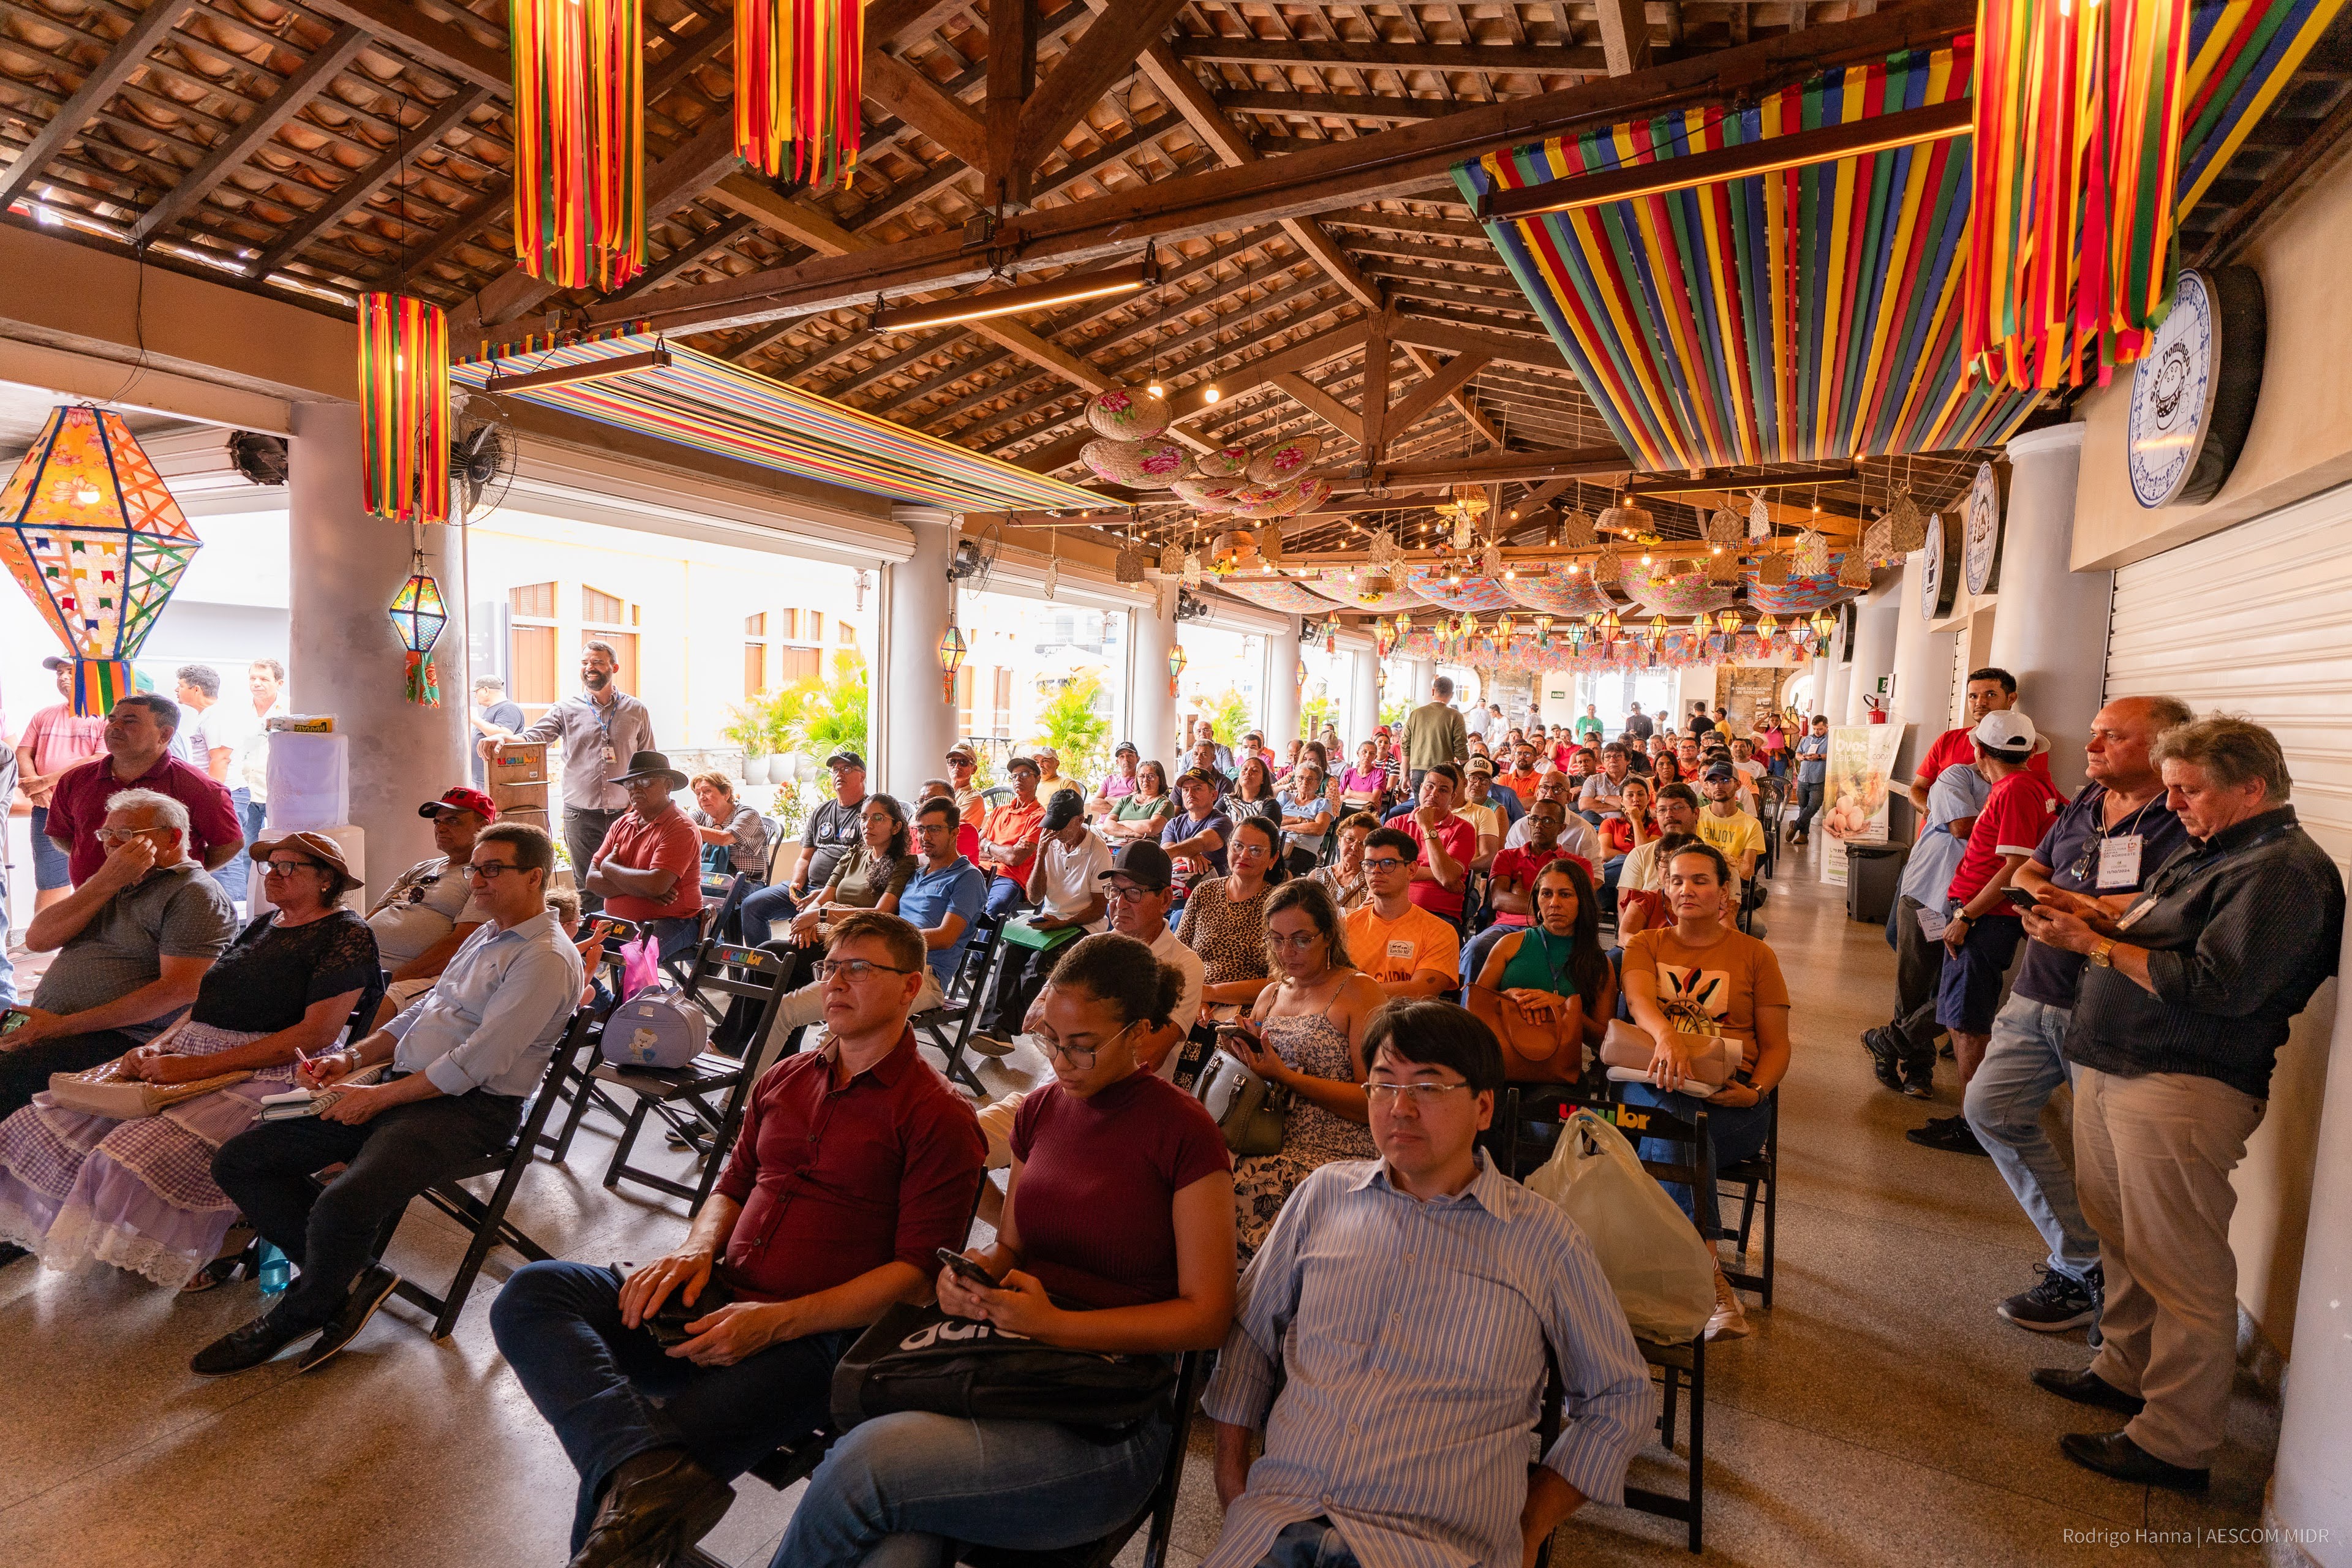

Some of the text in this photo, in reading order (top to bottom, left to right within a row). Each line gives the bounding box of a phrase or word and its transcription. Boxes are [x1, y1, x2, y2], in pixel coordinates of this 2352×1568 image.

[2163, 338, 2190, 377] Domingos
[1836, 739, 1867, 752] Ovos
[497, 753, 538, 765] uaubr
[1473, 760, 1488, 769] AGRO
[1834, 753, 1861, 763] Caipira
[1704, 827, 1735, 843] ENJOY
[722, 950, 763, 966] uaubr
[1559, 1104, 1650, 1130] uubr
